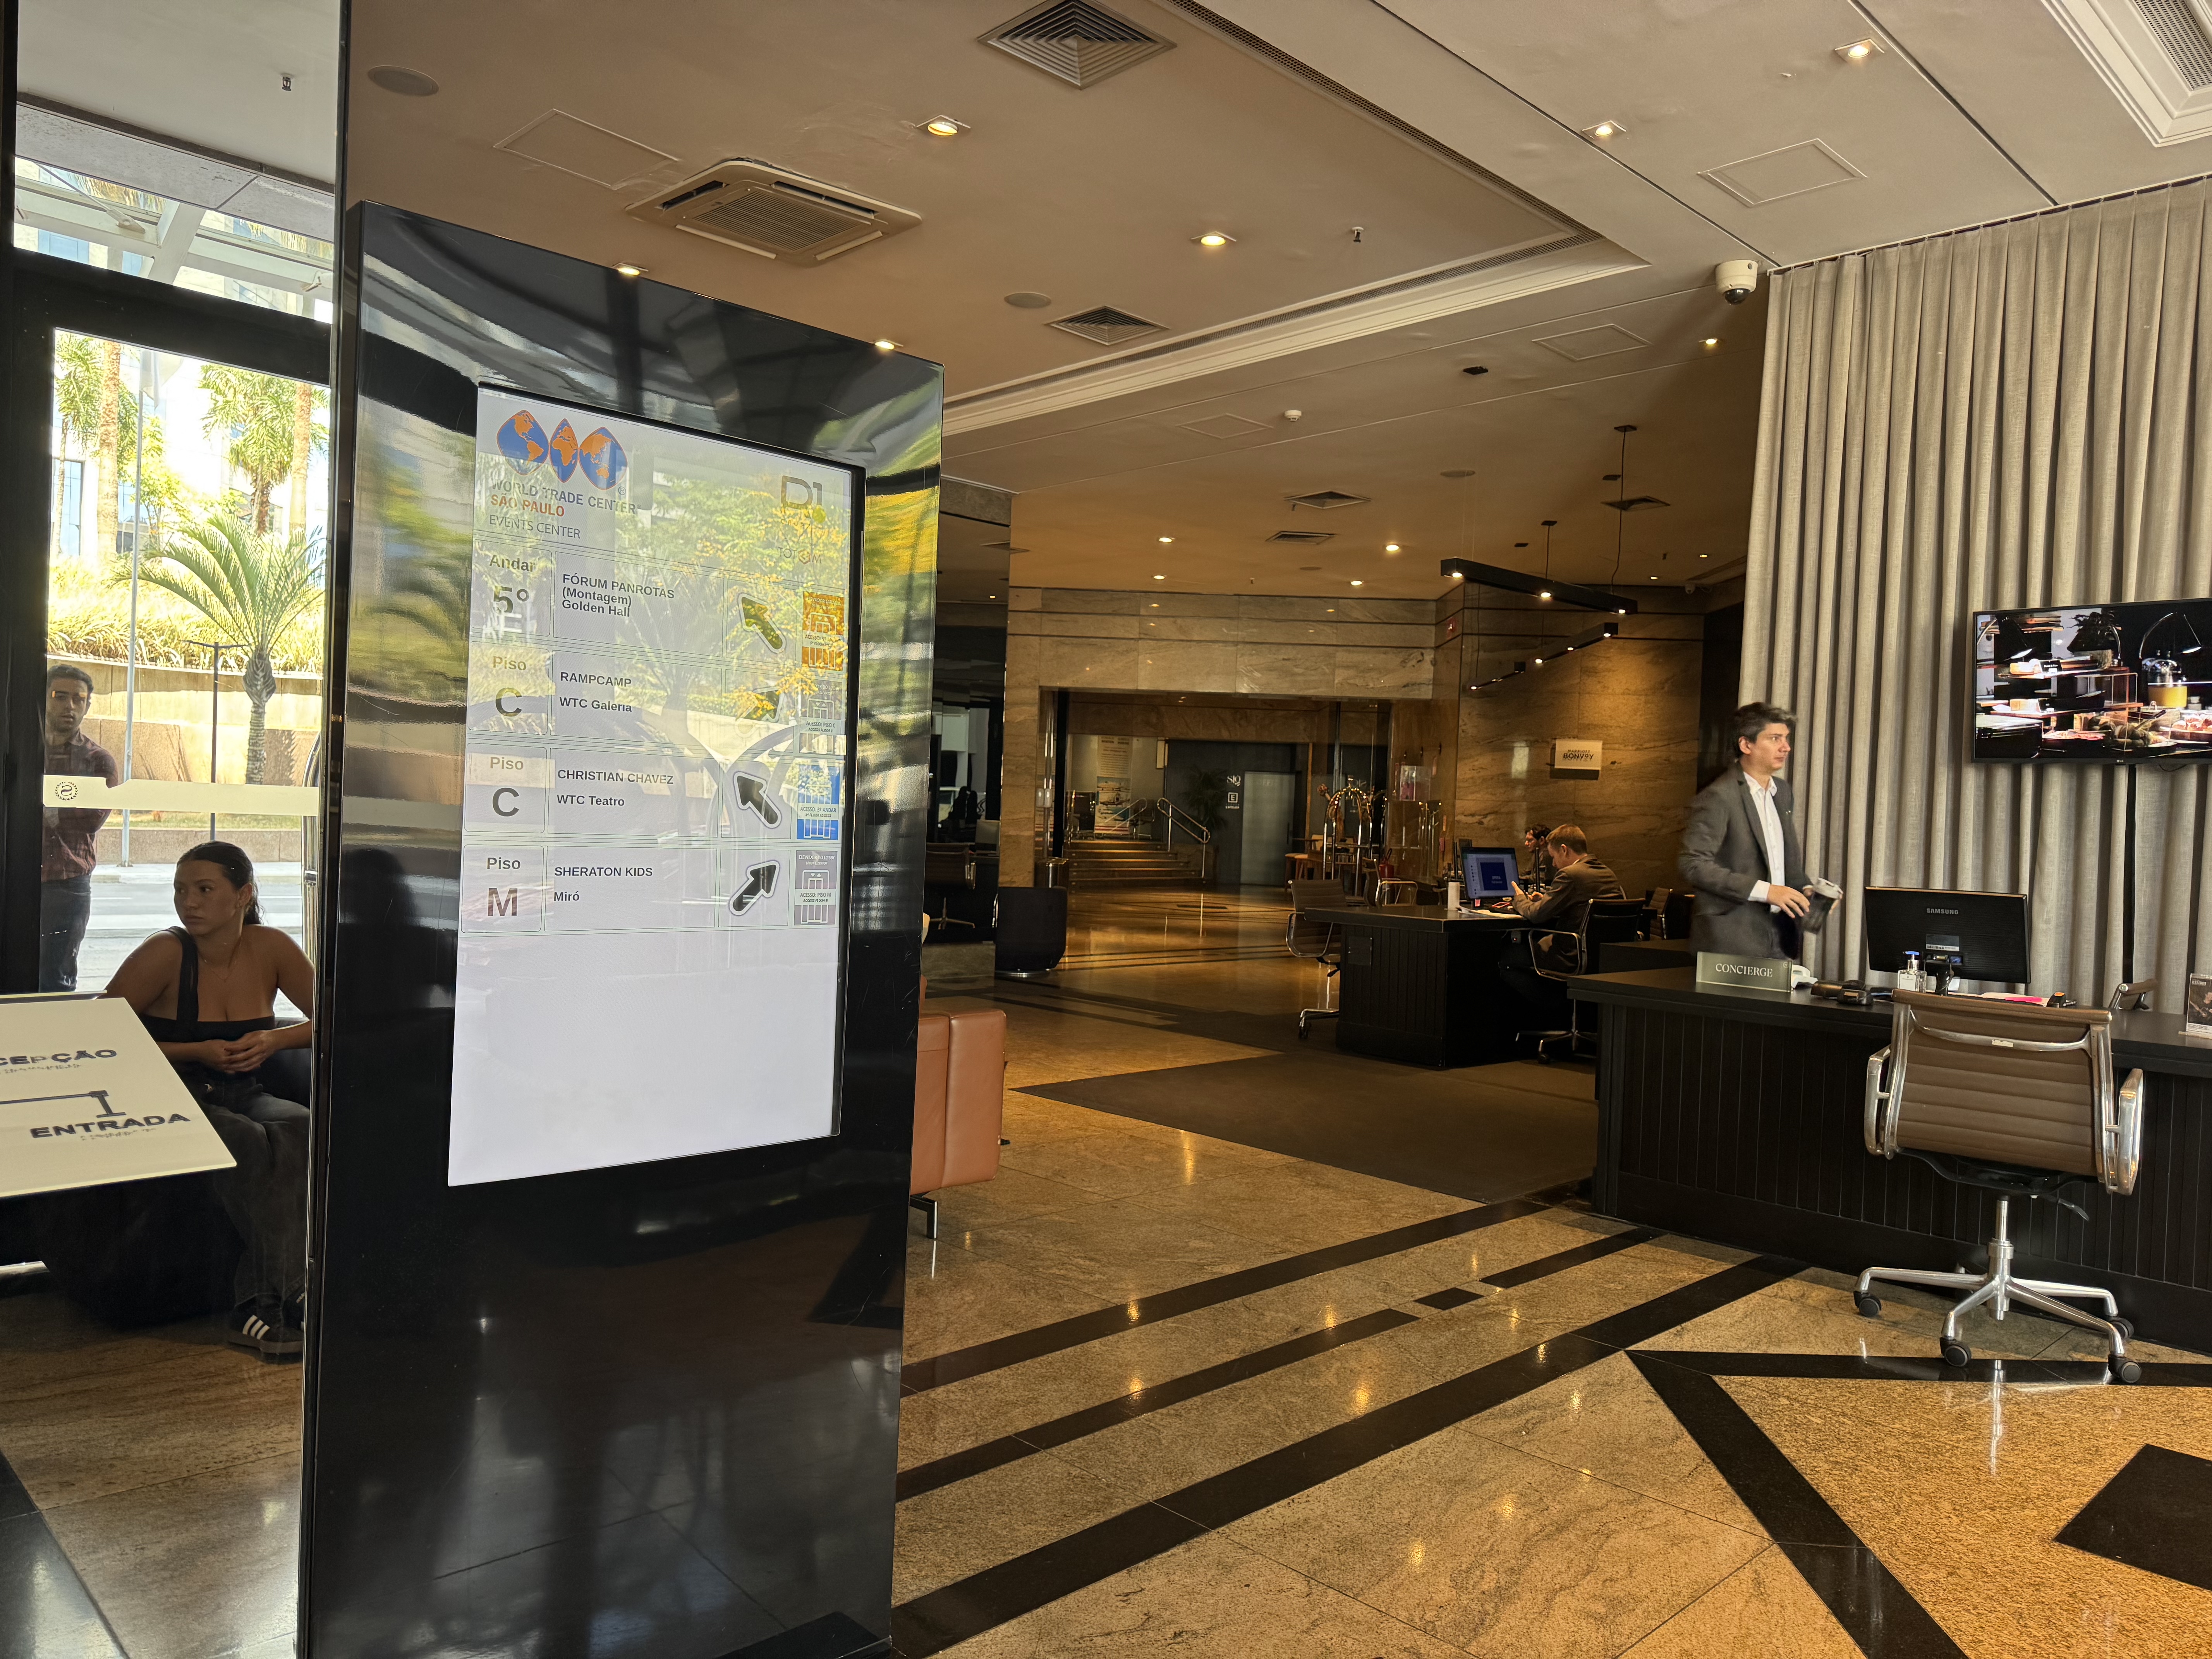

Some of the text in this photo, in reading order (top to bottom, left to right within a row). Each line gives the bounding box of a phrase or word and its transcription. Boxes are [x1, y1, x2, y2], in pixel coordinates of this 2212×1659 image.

[491, 479, 538, 497] WORLD
[543, 487, 583, 505] TRADE
[491, 493, 565, 517] SÃO PAULO
[490, 515, 580, 539] EVENTS CENTER
[489, 555, 536, 572] Andar
[563, 573, 675, 599] FÓRUM PANROTAS
[562, 586, 632, 607] (Montagem)
[562, 599, 630, 617] Golden Hall
[492, 656, 527, 671] Piso
[560, 672, 632, 687] RAMPCAMP
[495, 687, 523, 717] C
[560, 697, 632, 713] WTC Galeria
[490, 756, 524, 770] Piso
[557, 769, 674, 785] CHRISTIAN CHAVEZ
[492, 787, 520, 817] C
[557, 794, 625, 806] WTC Teatro
[487, 857, 521, 870] Piso
[554, 867, 653, 877] SHERATON KIDS
[487, 888, 518, 917] M
[553, 891, 580, 902] Miró
[1716, 963, 1773, 977] CONCIERGE
[30, 1113, 191, 1139] ENTRADA
